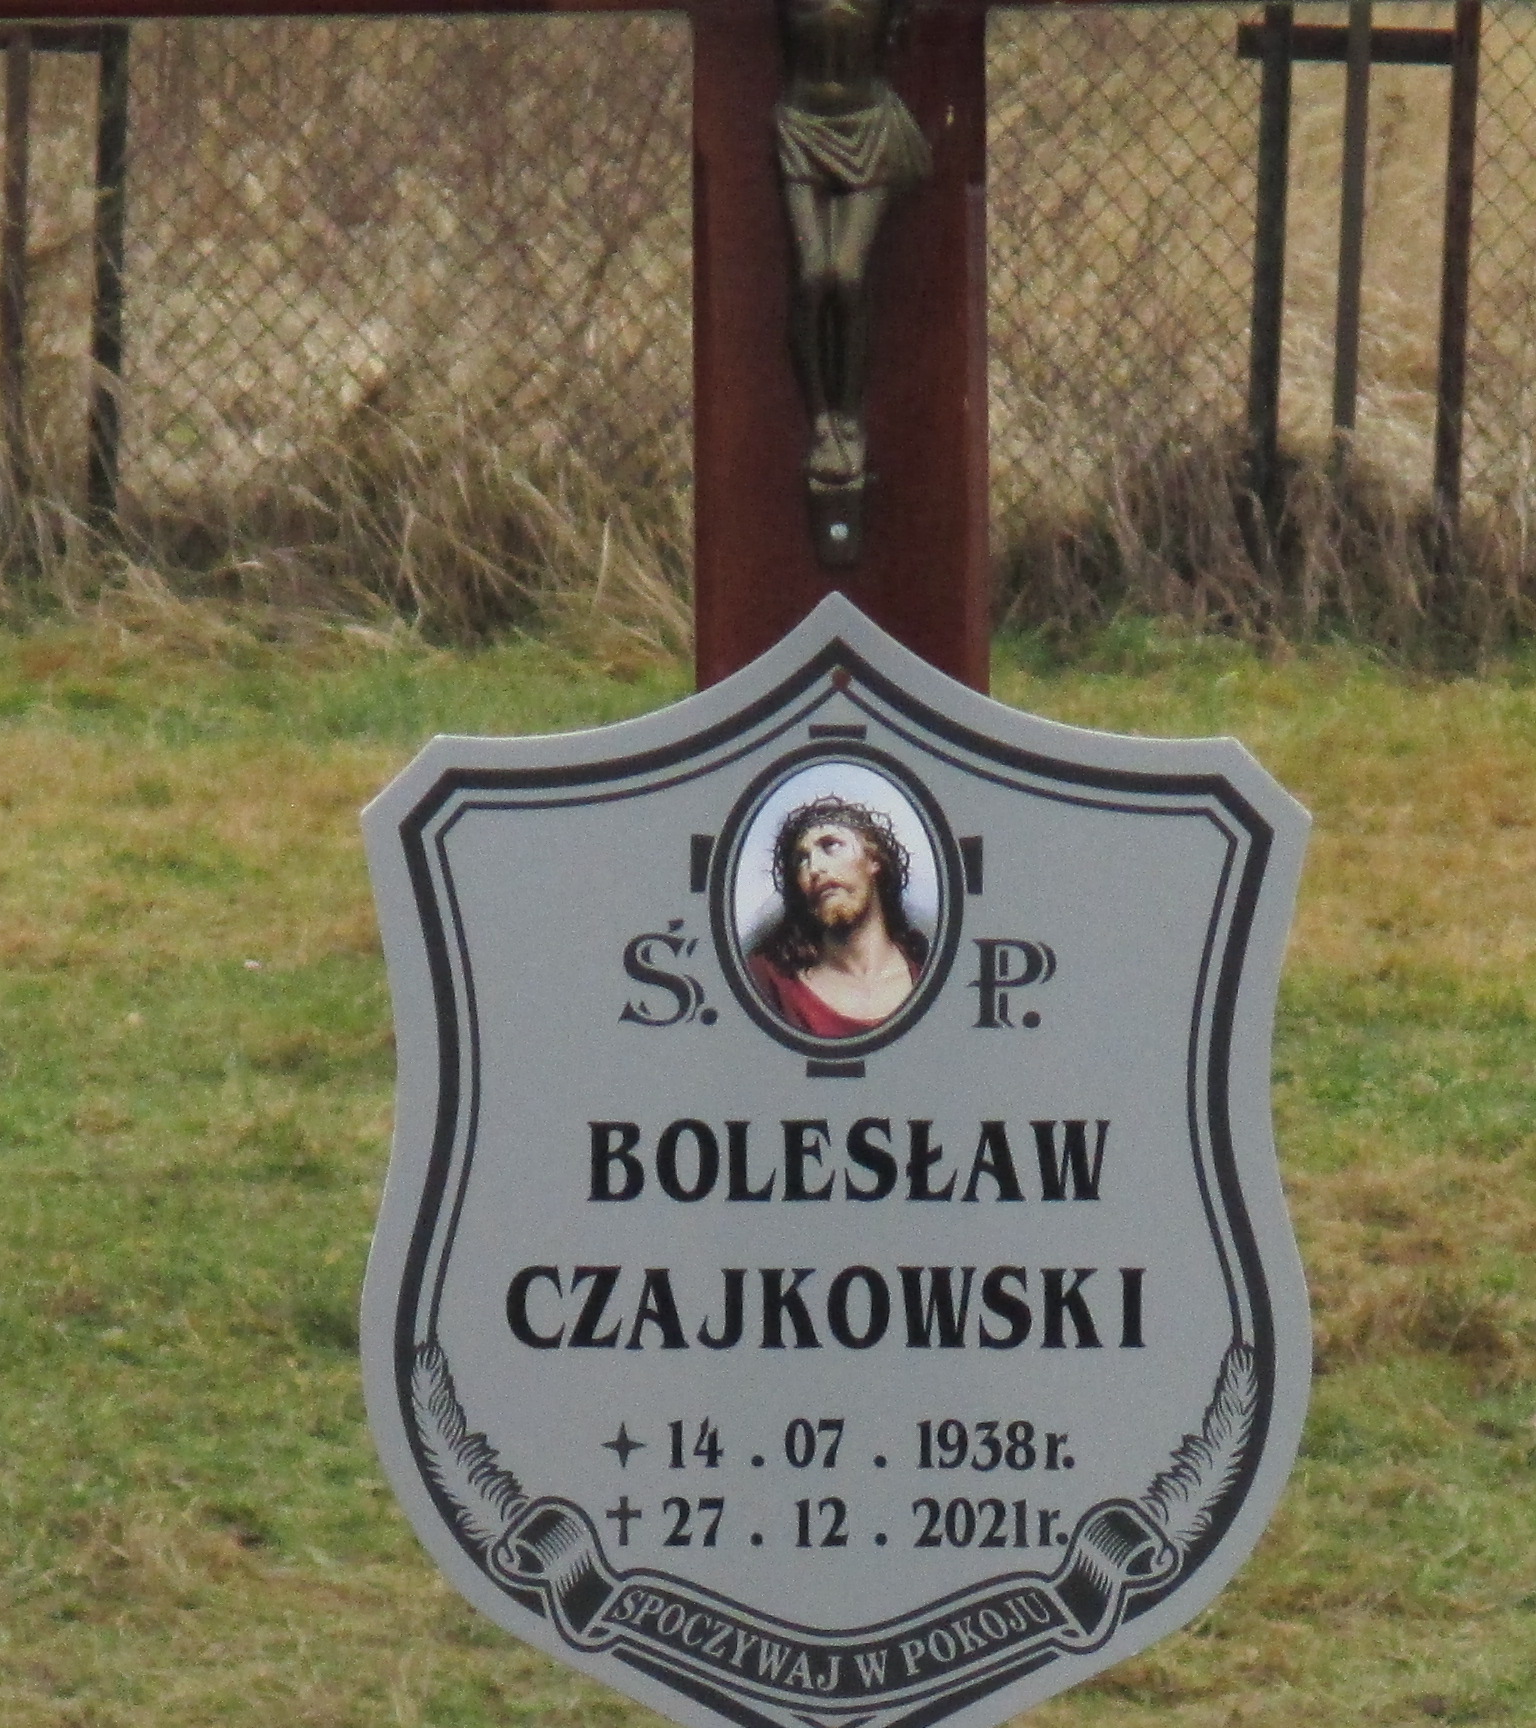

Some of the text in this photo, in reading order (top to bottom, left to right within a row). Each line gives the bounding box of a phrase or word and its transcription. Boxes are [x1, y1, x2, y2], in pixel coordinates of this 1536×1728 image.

[617, 918, 1058, 1030] Ś. P.
[586, 1116, 1112, 1204] BOLESŁAW
[504, 1263, 1147, 1353] CZAJKOWSKI
[916, 1418, 1076, 1473] 1938r.
[911, 1496, 1069, 1549] 2021r.
[611, 1589, 1054, 1693] SPOCZYWAJ W POKOJU
